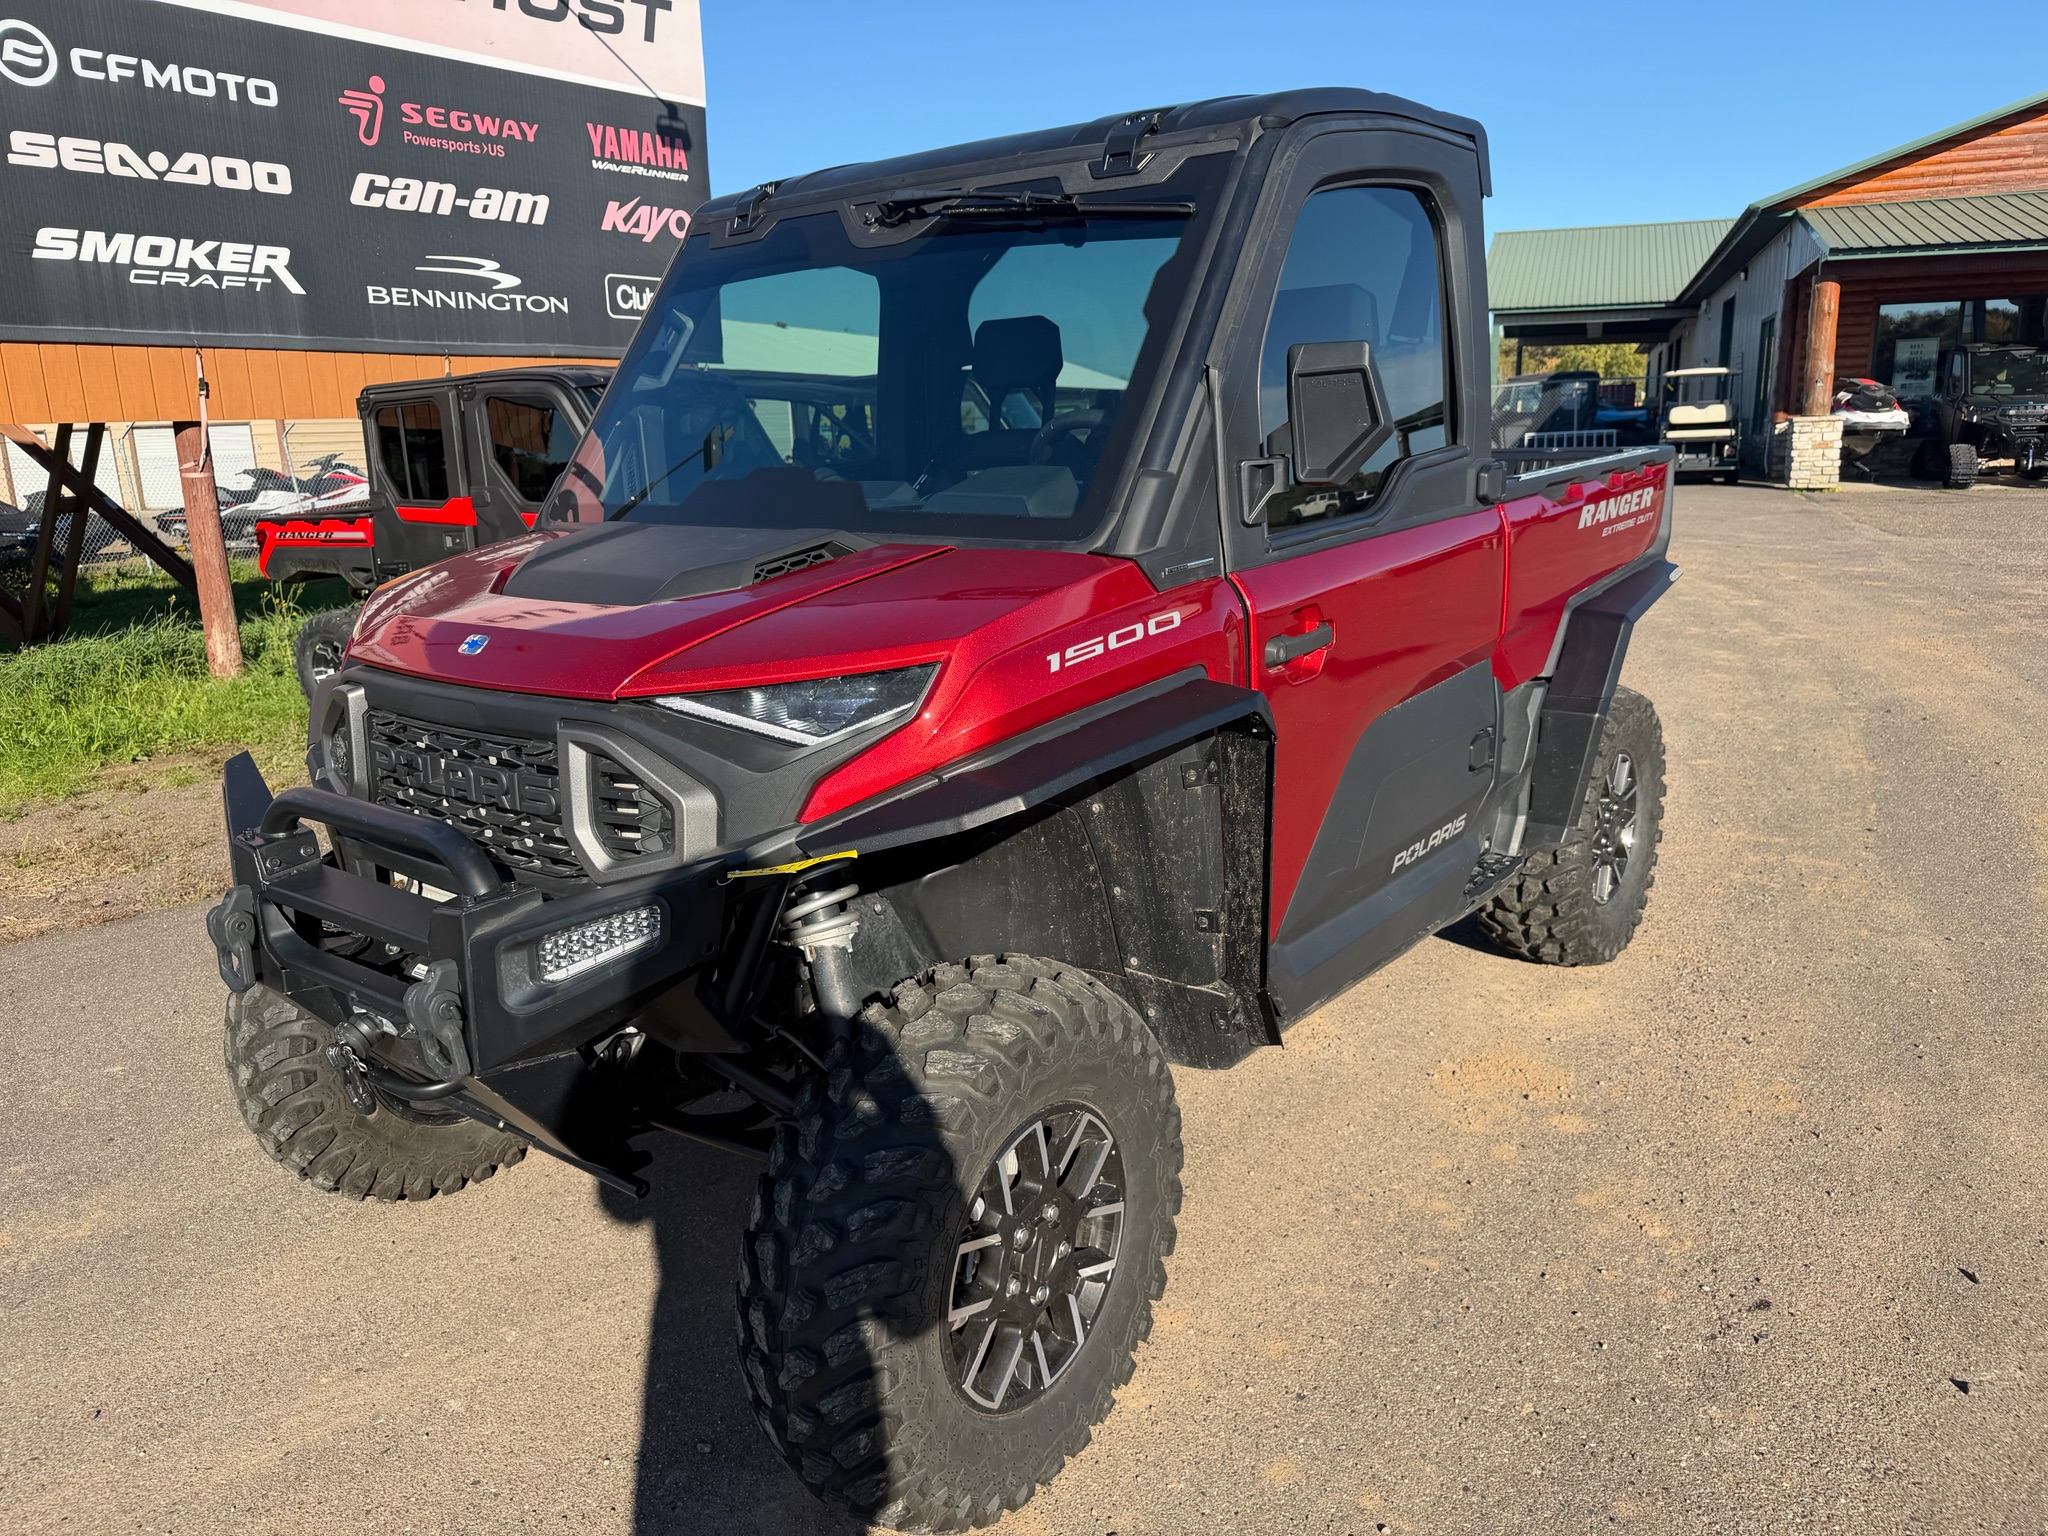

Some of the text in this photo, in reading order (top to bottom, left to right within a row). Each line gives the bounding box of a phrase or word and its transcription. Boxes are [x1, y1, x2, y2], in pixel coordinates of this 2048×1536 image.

[491, 0, 672, 43] OST
[70, 47, 279, 107] CFMOTO
[400, 102, 539, 143] SEGWAY
[586, 122, 689, 171] YAMAHA
[601, 196, 692, 243] KAYO
[31, 227, 307, 295] SMOKER
[129, 269, 272, 292] CRAFT
[366, 285, 570, 314] BENNINGTON
[1305, 377, 1359, 390] POLARIS
[1578, 486, 1654, 530] RANGER
[1601, 511, 1654, 537] EXTREME DUTY
[278, 531, 335, 539] RANGER
[1046, 610, 1181, 673] 1500
[369, 739, 561, 817] POLARIS
[1391, 812, 1468, 875] POLARIS
